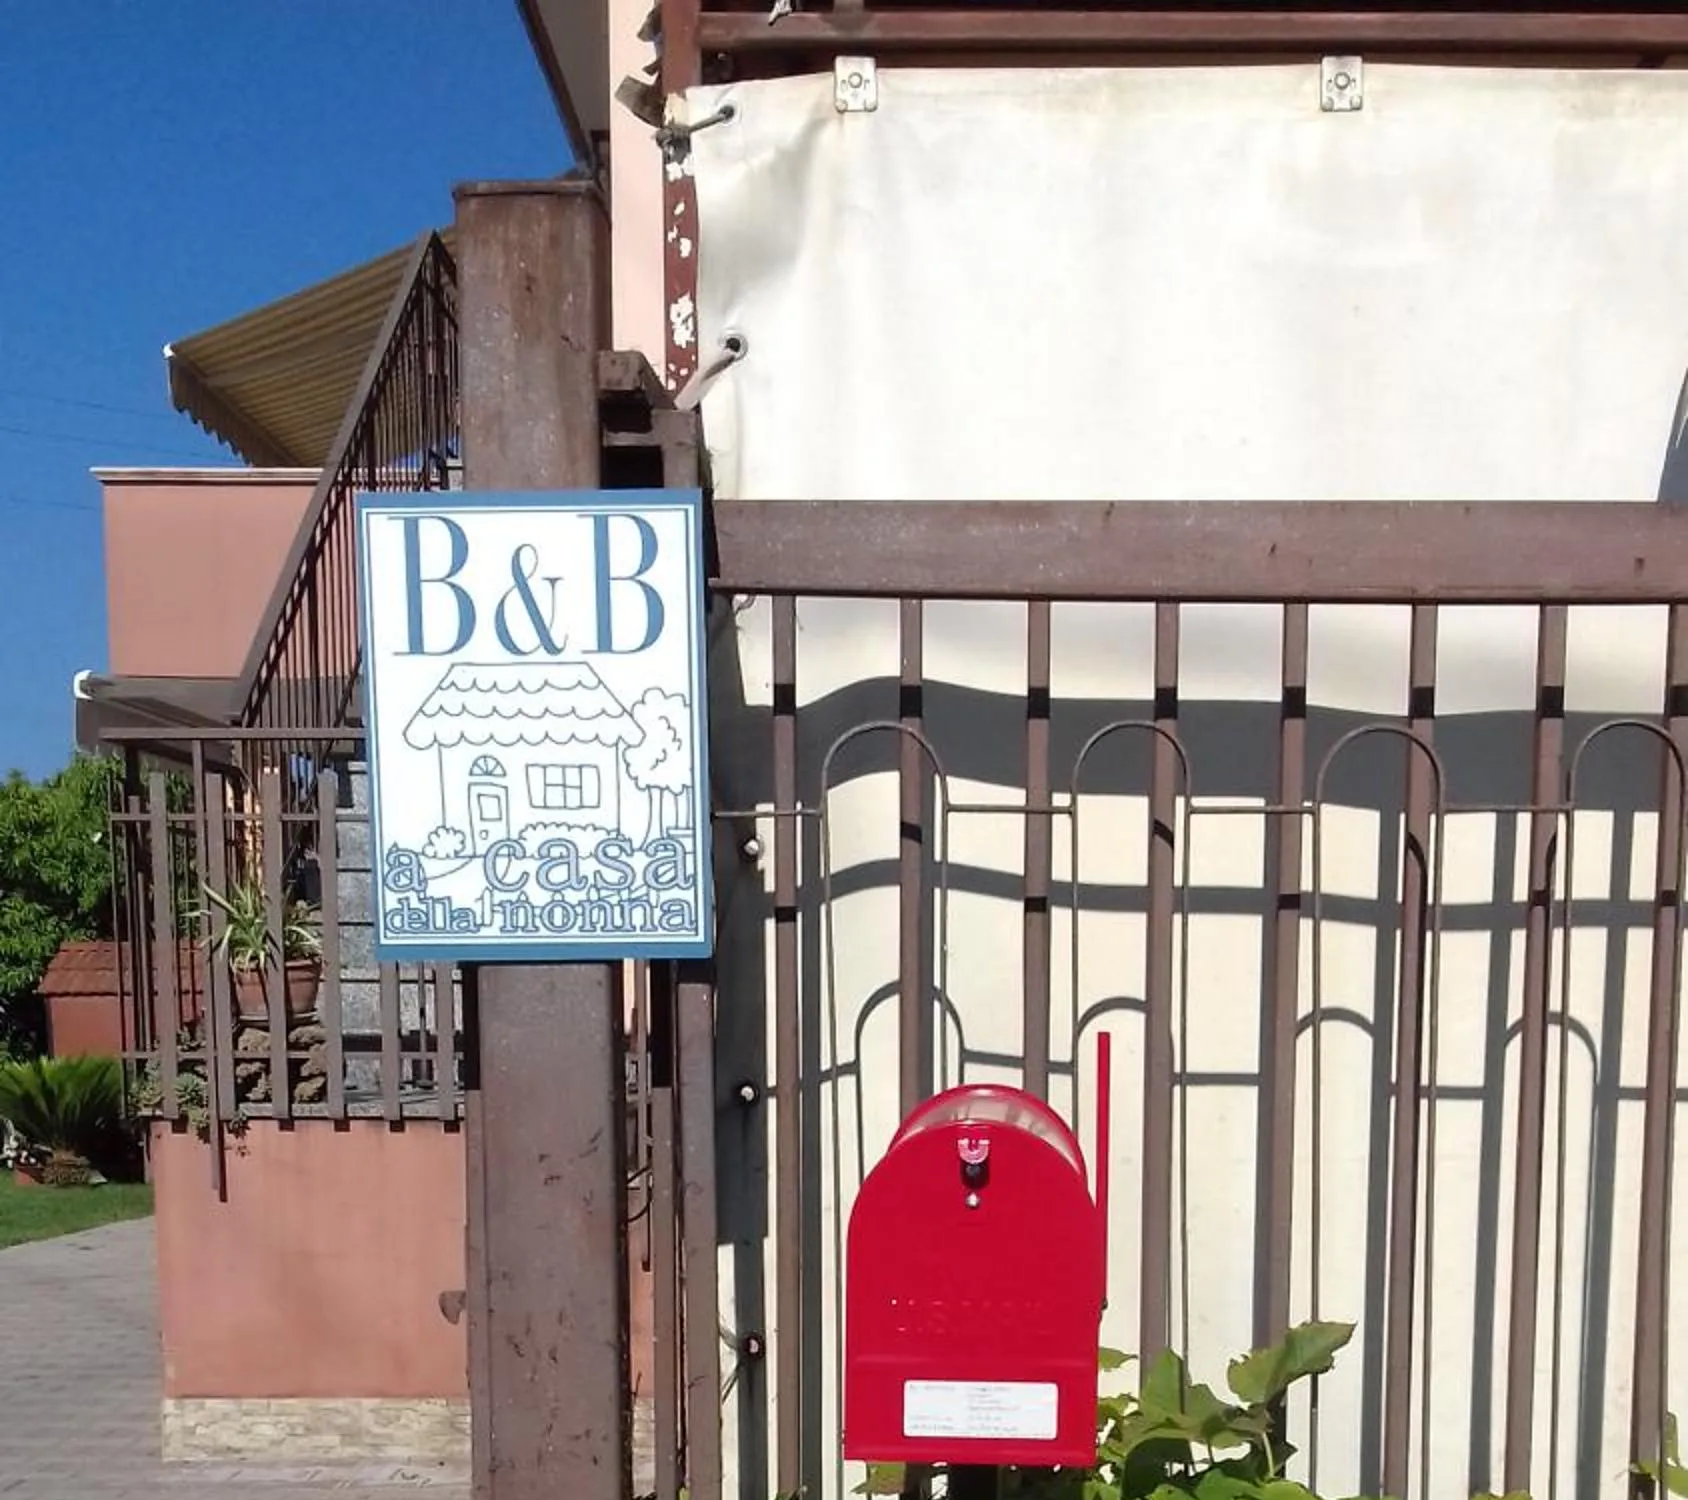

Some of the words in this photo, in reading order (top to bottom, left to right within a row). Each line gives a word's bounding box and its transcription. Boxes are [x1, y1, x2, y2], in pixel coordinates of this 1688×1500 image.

[388, 514, 665, 656] B&B
[385, 847, 425, 893] a
[483, 838, 696, 893] casa
[385, 897, 480, 935] della
[500, 898, 698, 935] nonna
